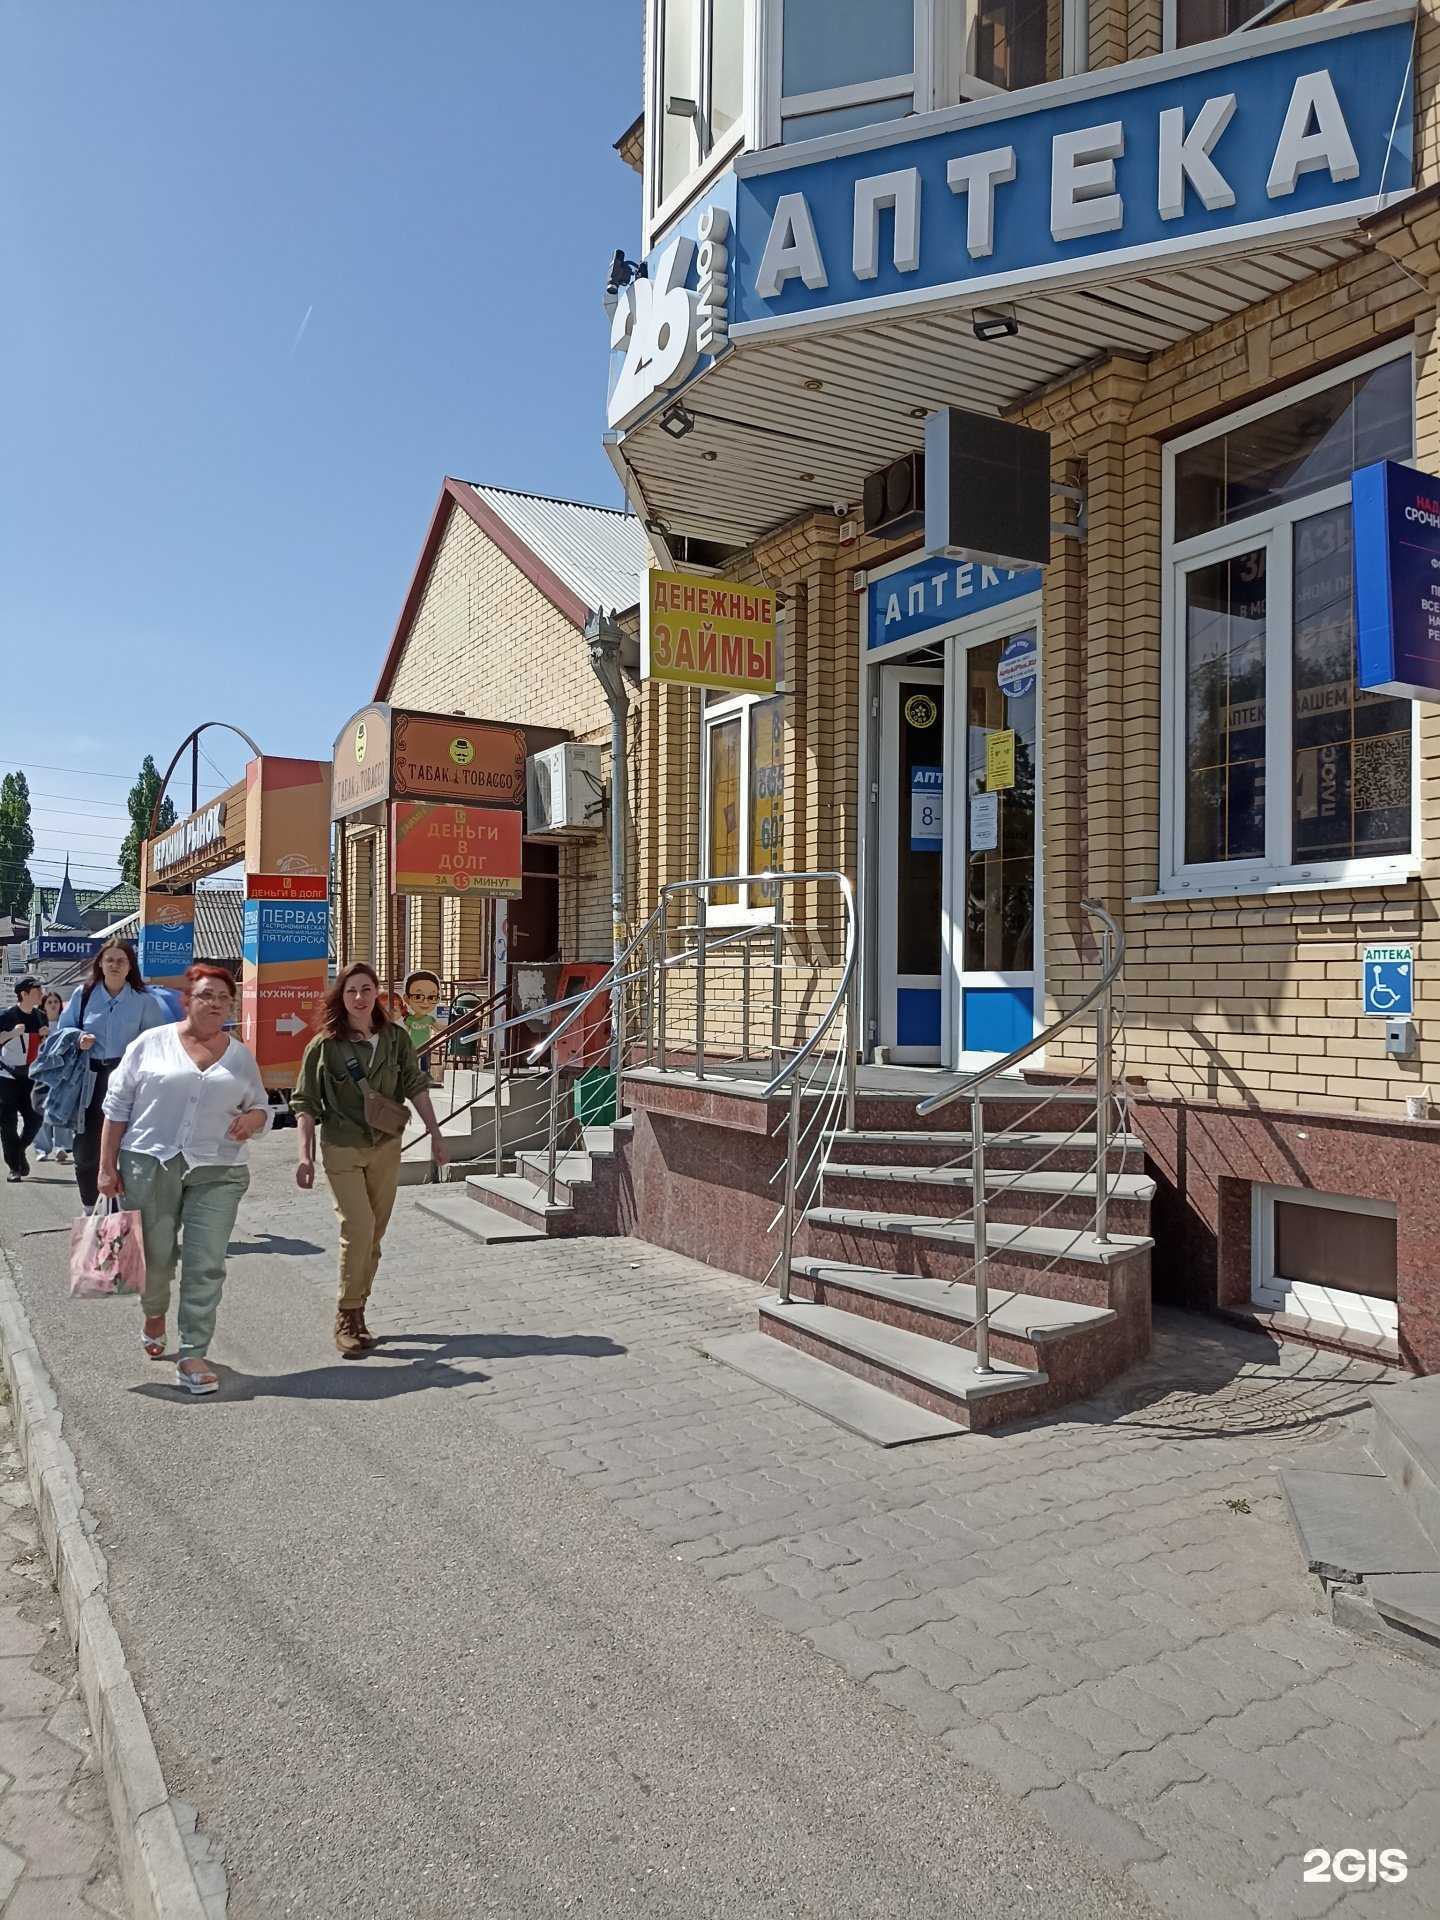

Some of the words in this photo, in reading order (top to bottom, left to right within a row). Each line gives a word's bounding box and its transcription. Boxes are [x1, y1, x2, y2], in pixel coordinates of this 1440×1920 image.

[755, 69, 1360, 298] АПТЕКА
[696, 205, 729, 354] ПЛЮС
[608, 236, 702, 430] 26
[885, 562, 1015, 626] АПТЕК
[655, 581, 771, 624] ДЕНЕЖНЫЕ
[655, 622, 772, 680] ЗАЙМЫ
[408, 763, 449, 783] ТАБАК
[462, 770, 513, 789] TOBACCO
[428, 823, 498, 841] ДЕНЬГИ
[458, 841, 468, 854] В
[438, 854, 487, 870] ДОЛГ
[434, 875, 448, 885] ЗА
[473, 877, 510, 888] МИНУТ
[251, 888, 288, 898] ДЕНЬГИ
[291, 889, 297, 897] В
[299, 889, 323, 898] ДОЛГ
[262, 909, 327, 924] ПЕРВАЯ
[42, 941, 93, 953] РЕМОНТ
[146, 941, 192, 952] ПЕРВАЯ
[262, 935, 326, 944] ПЯТИГОРСКА
[1366, 949, 1412, 960] АПТЕКА
[259, 990, 295, 999] КУХНИ
